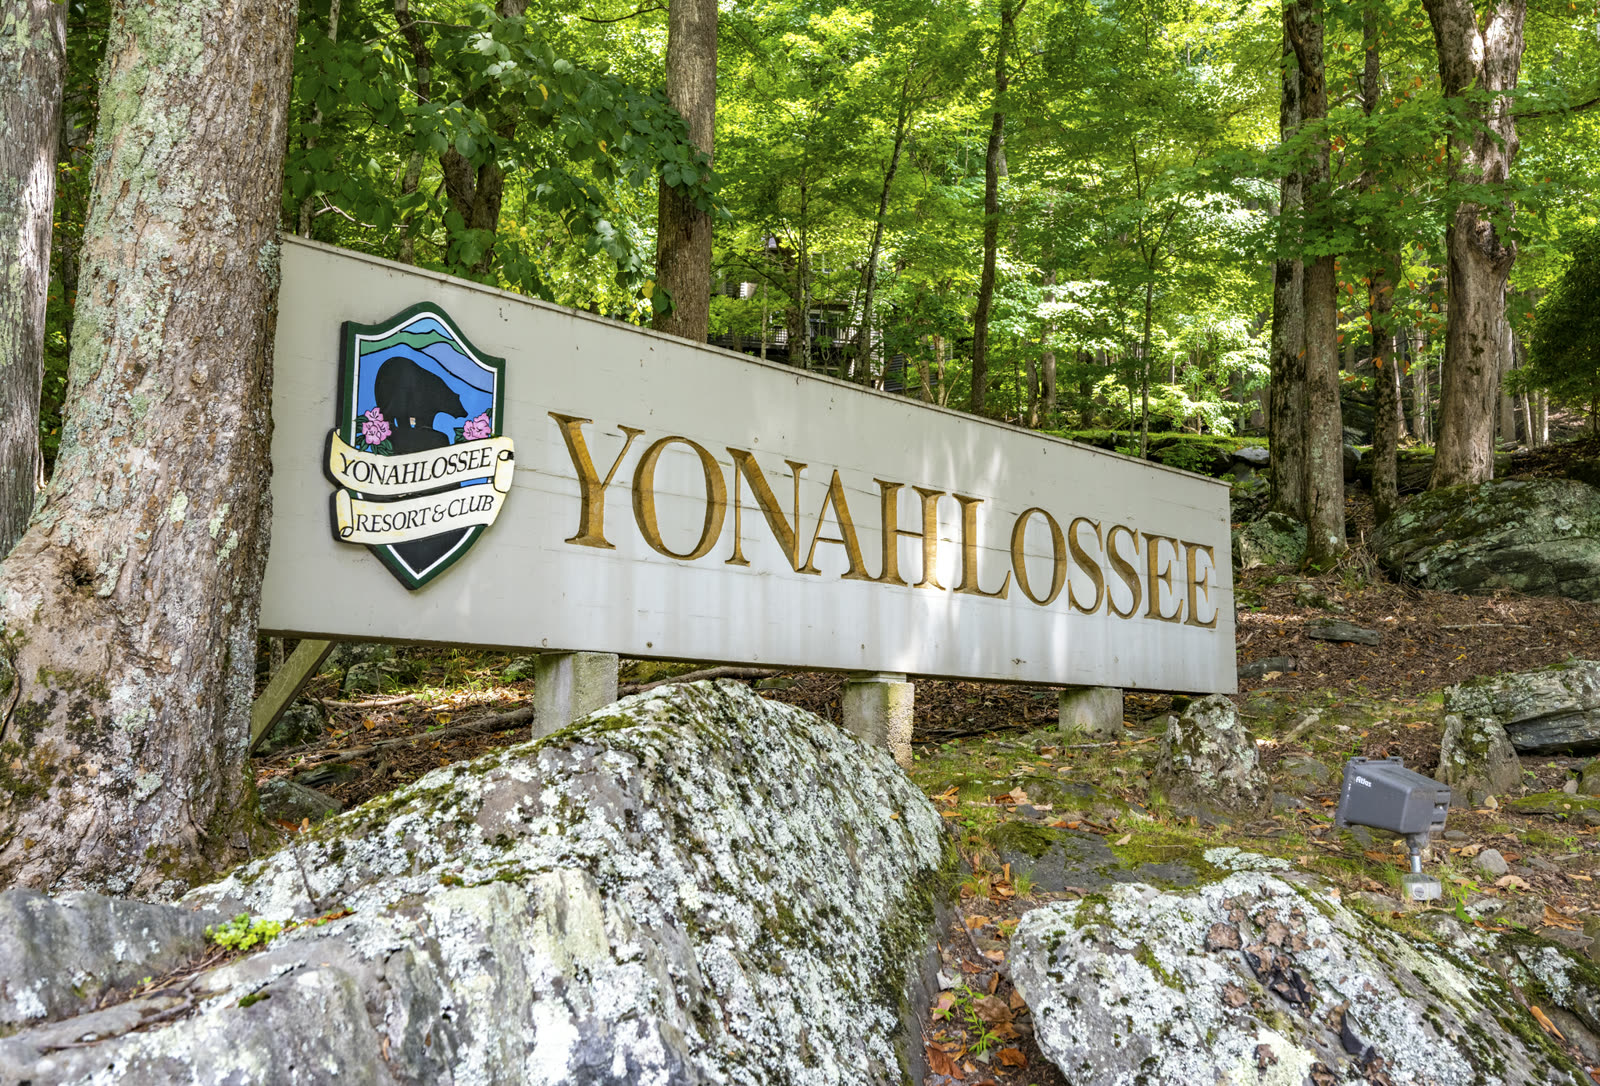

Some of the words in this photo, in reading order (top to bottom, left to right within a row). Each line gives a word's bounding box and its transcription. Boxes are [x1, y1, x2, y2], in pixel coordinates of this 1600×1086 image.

[339, 446, 493, 486] YONAHLOSSEE
[355, 506, 431, 533] RESORT
[447, 495, 495, 518] CLUB
[547, 410, 1219, 630] YONAHLOSSEE
[1355, 775, 1372, 788] Atlas
